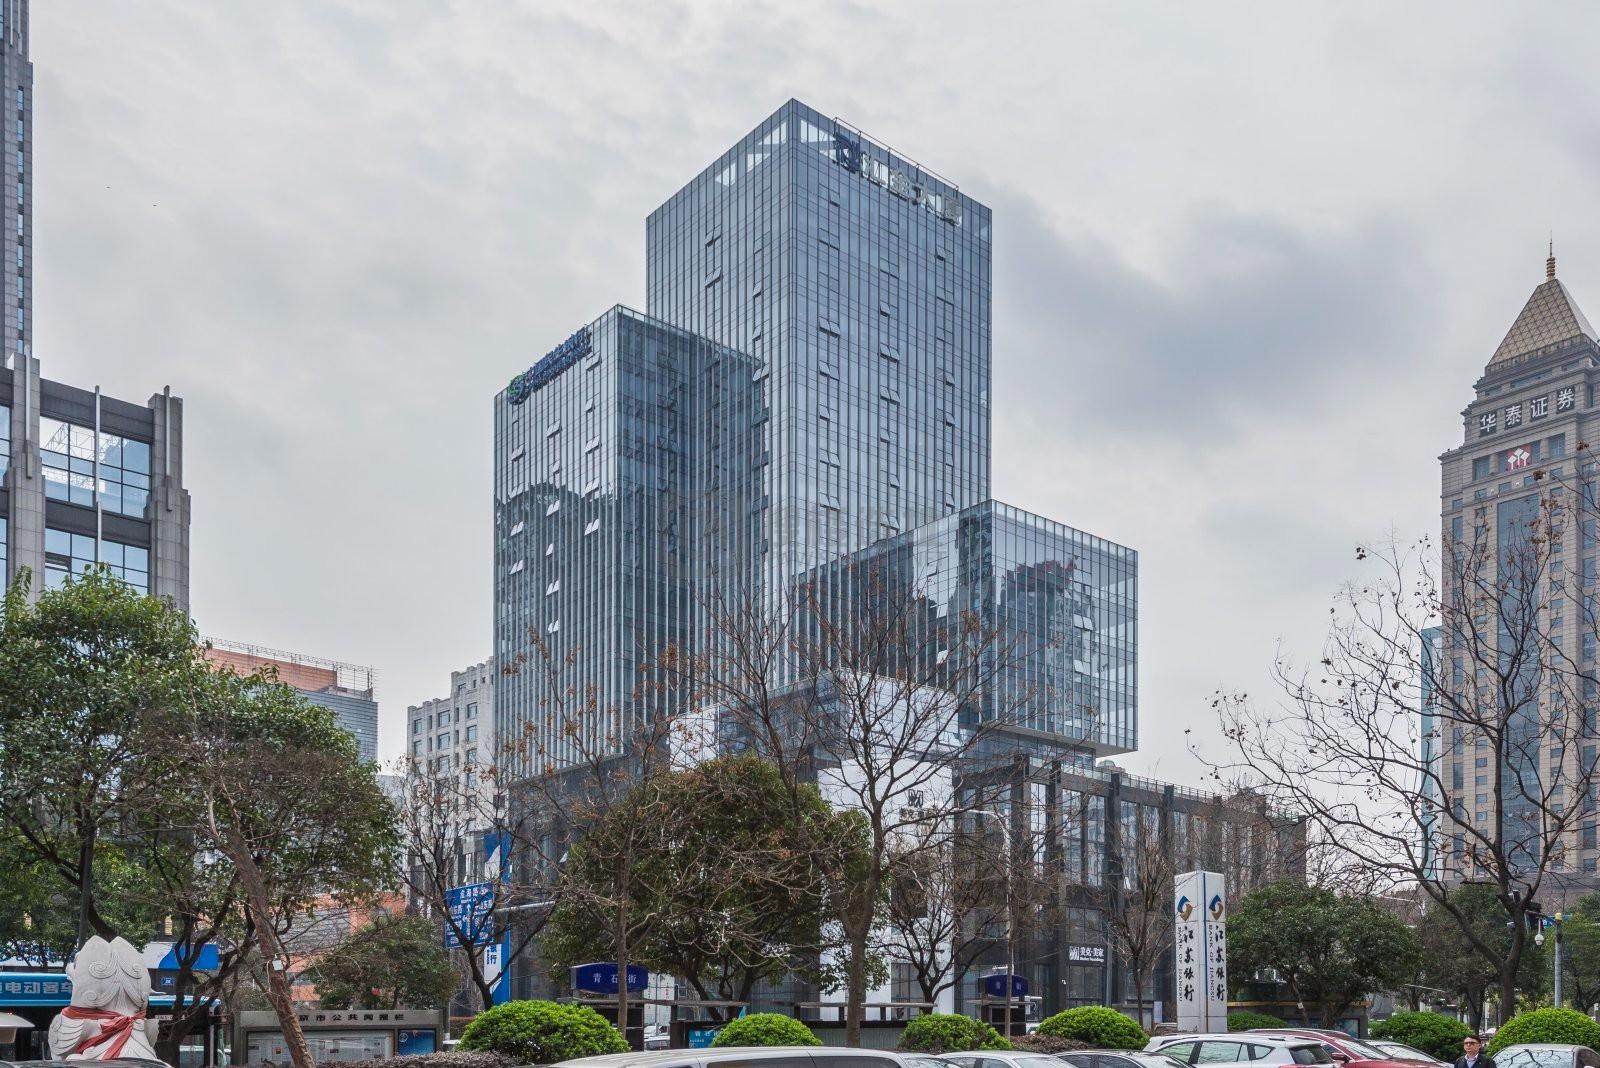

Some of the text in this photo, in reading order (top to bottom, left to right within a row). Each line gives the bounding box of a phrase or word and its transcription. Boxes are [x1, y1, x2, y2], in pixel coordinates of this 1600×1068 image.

[1480, 388, 1575, 433] 华泰证券
[593, 972, 637, 984] 青石街
[1184, 925, 1194, 1002] 江苏银行
[1215, 925, 1225, 1002] 江苏银行
[0, 981, 73, 994] 电动客车
